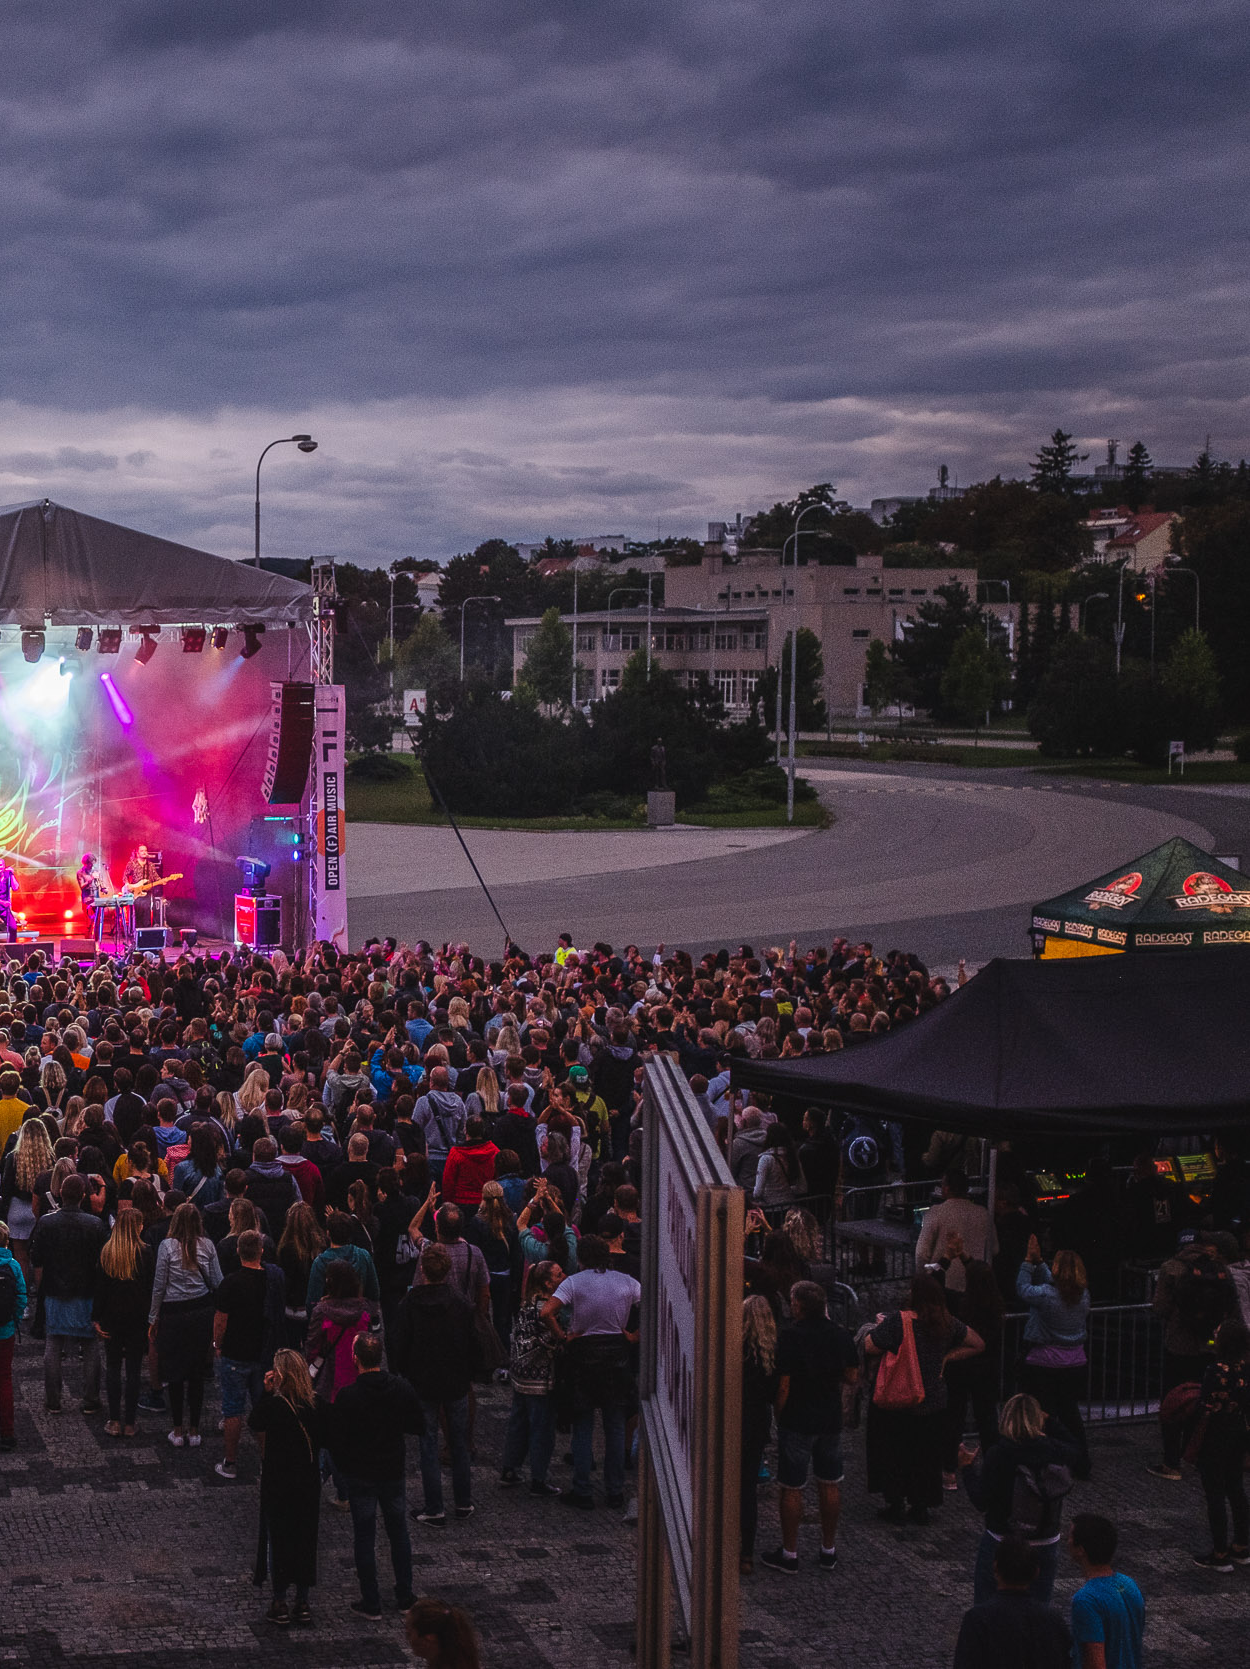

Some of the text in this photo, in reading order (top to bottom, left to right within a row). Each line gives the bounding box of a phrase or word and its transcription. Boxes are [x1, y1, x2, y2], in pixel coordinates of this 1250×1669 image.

[325, 776, 339, 886] OPEN (F)AIR MUSIC
[1175, 893, 1250, 908] RADEGAS
[1097, 928, 1128, 945] RADEGAST
[1135, 932, 1194, 946] RADEGAST
[1203, 930, 1250, 944] RADEGA
